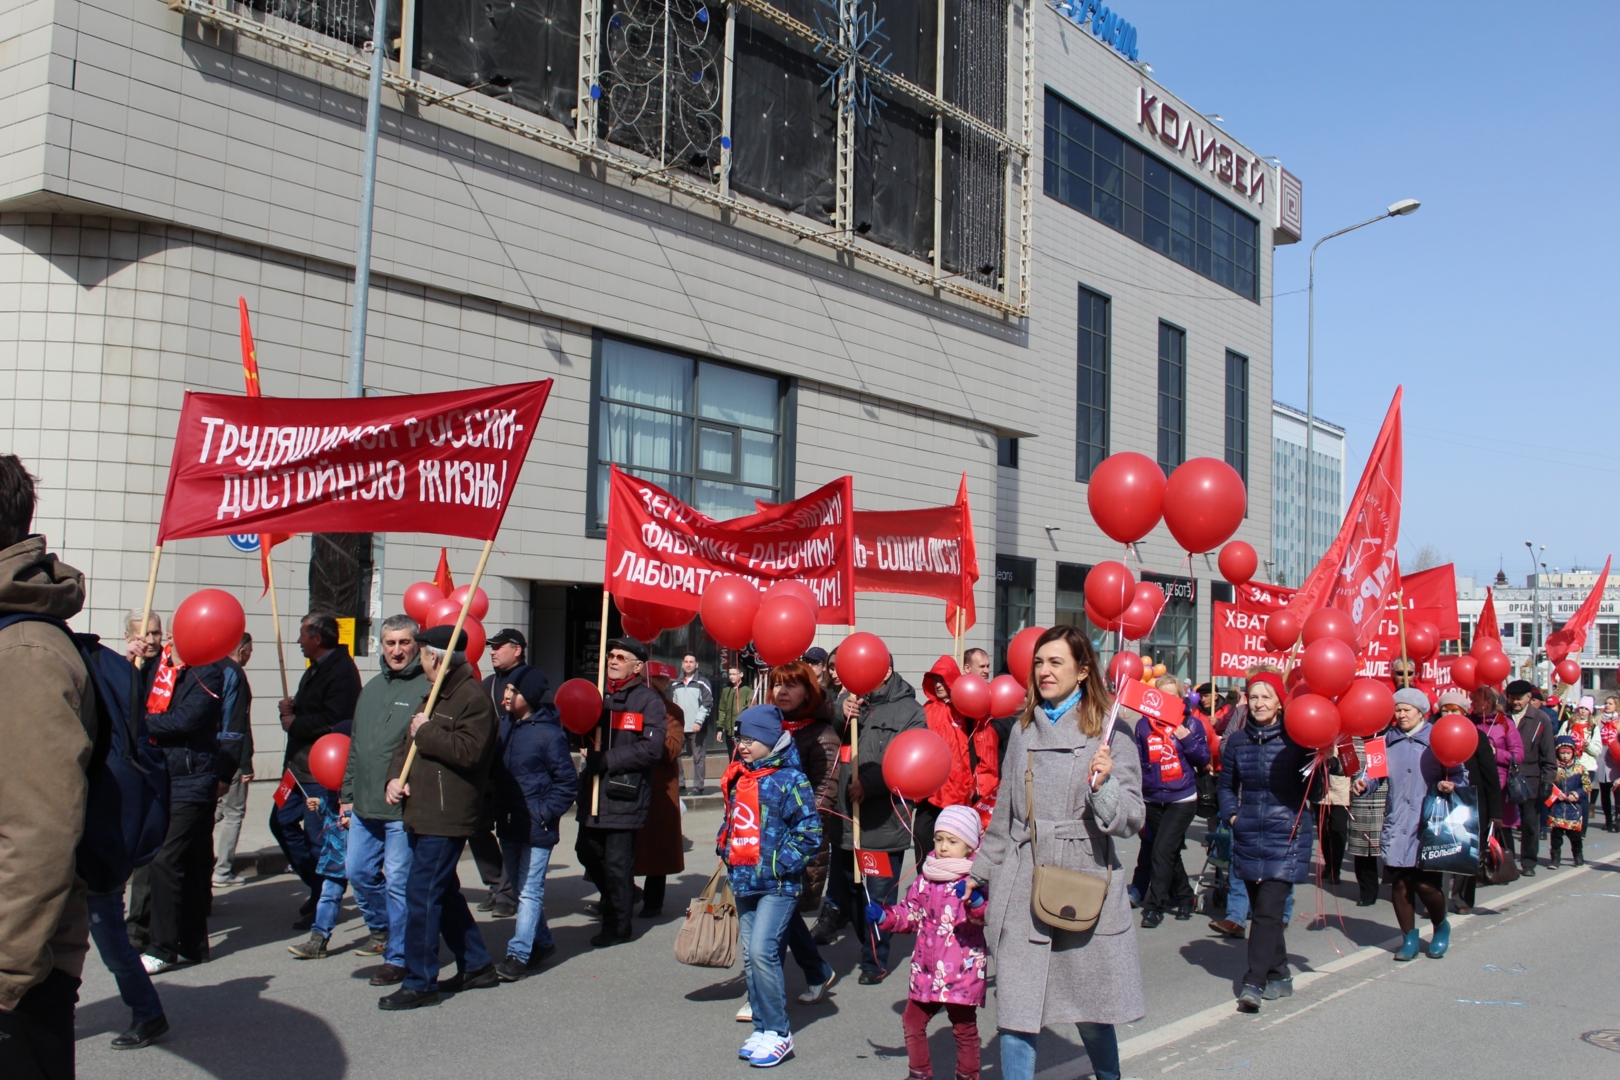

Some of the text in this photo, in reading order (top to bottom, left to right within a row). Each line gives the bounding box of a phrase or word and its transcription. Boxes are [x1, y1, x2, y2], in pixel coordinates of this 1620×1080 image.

[1137, 86, 1265, 204] КОЛИЗЕЙ
[217, 459, 507, 520] ДОСТОЙНУЮ ЖИЗНЬ!
[1139, 704, 1161, 716] КПРФ
[1161, 761, 1180, 771] КПРФ
[732, 836, 759, 846] КПРФ
[1421, 851, 1428, 861] К
